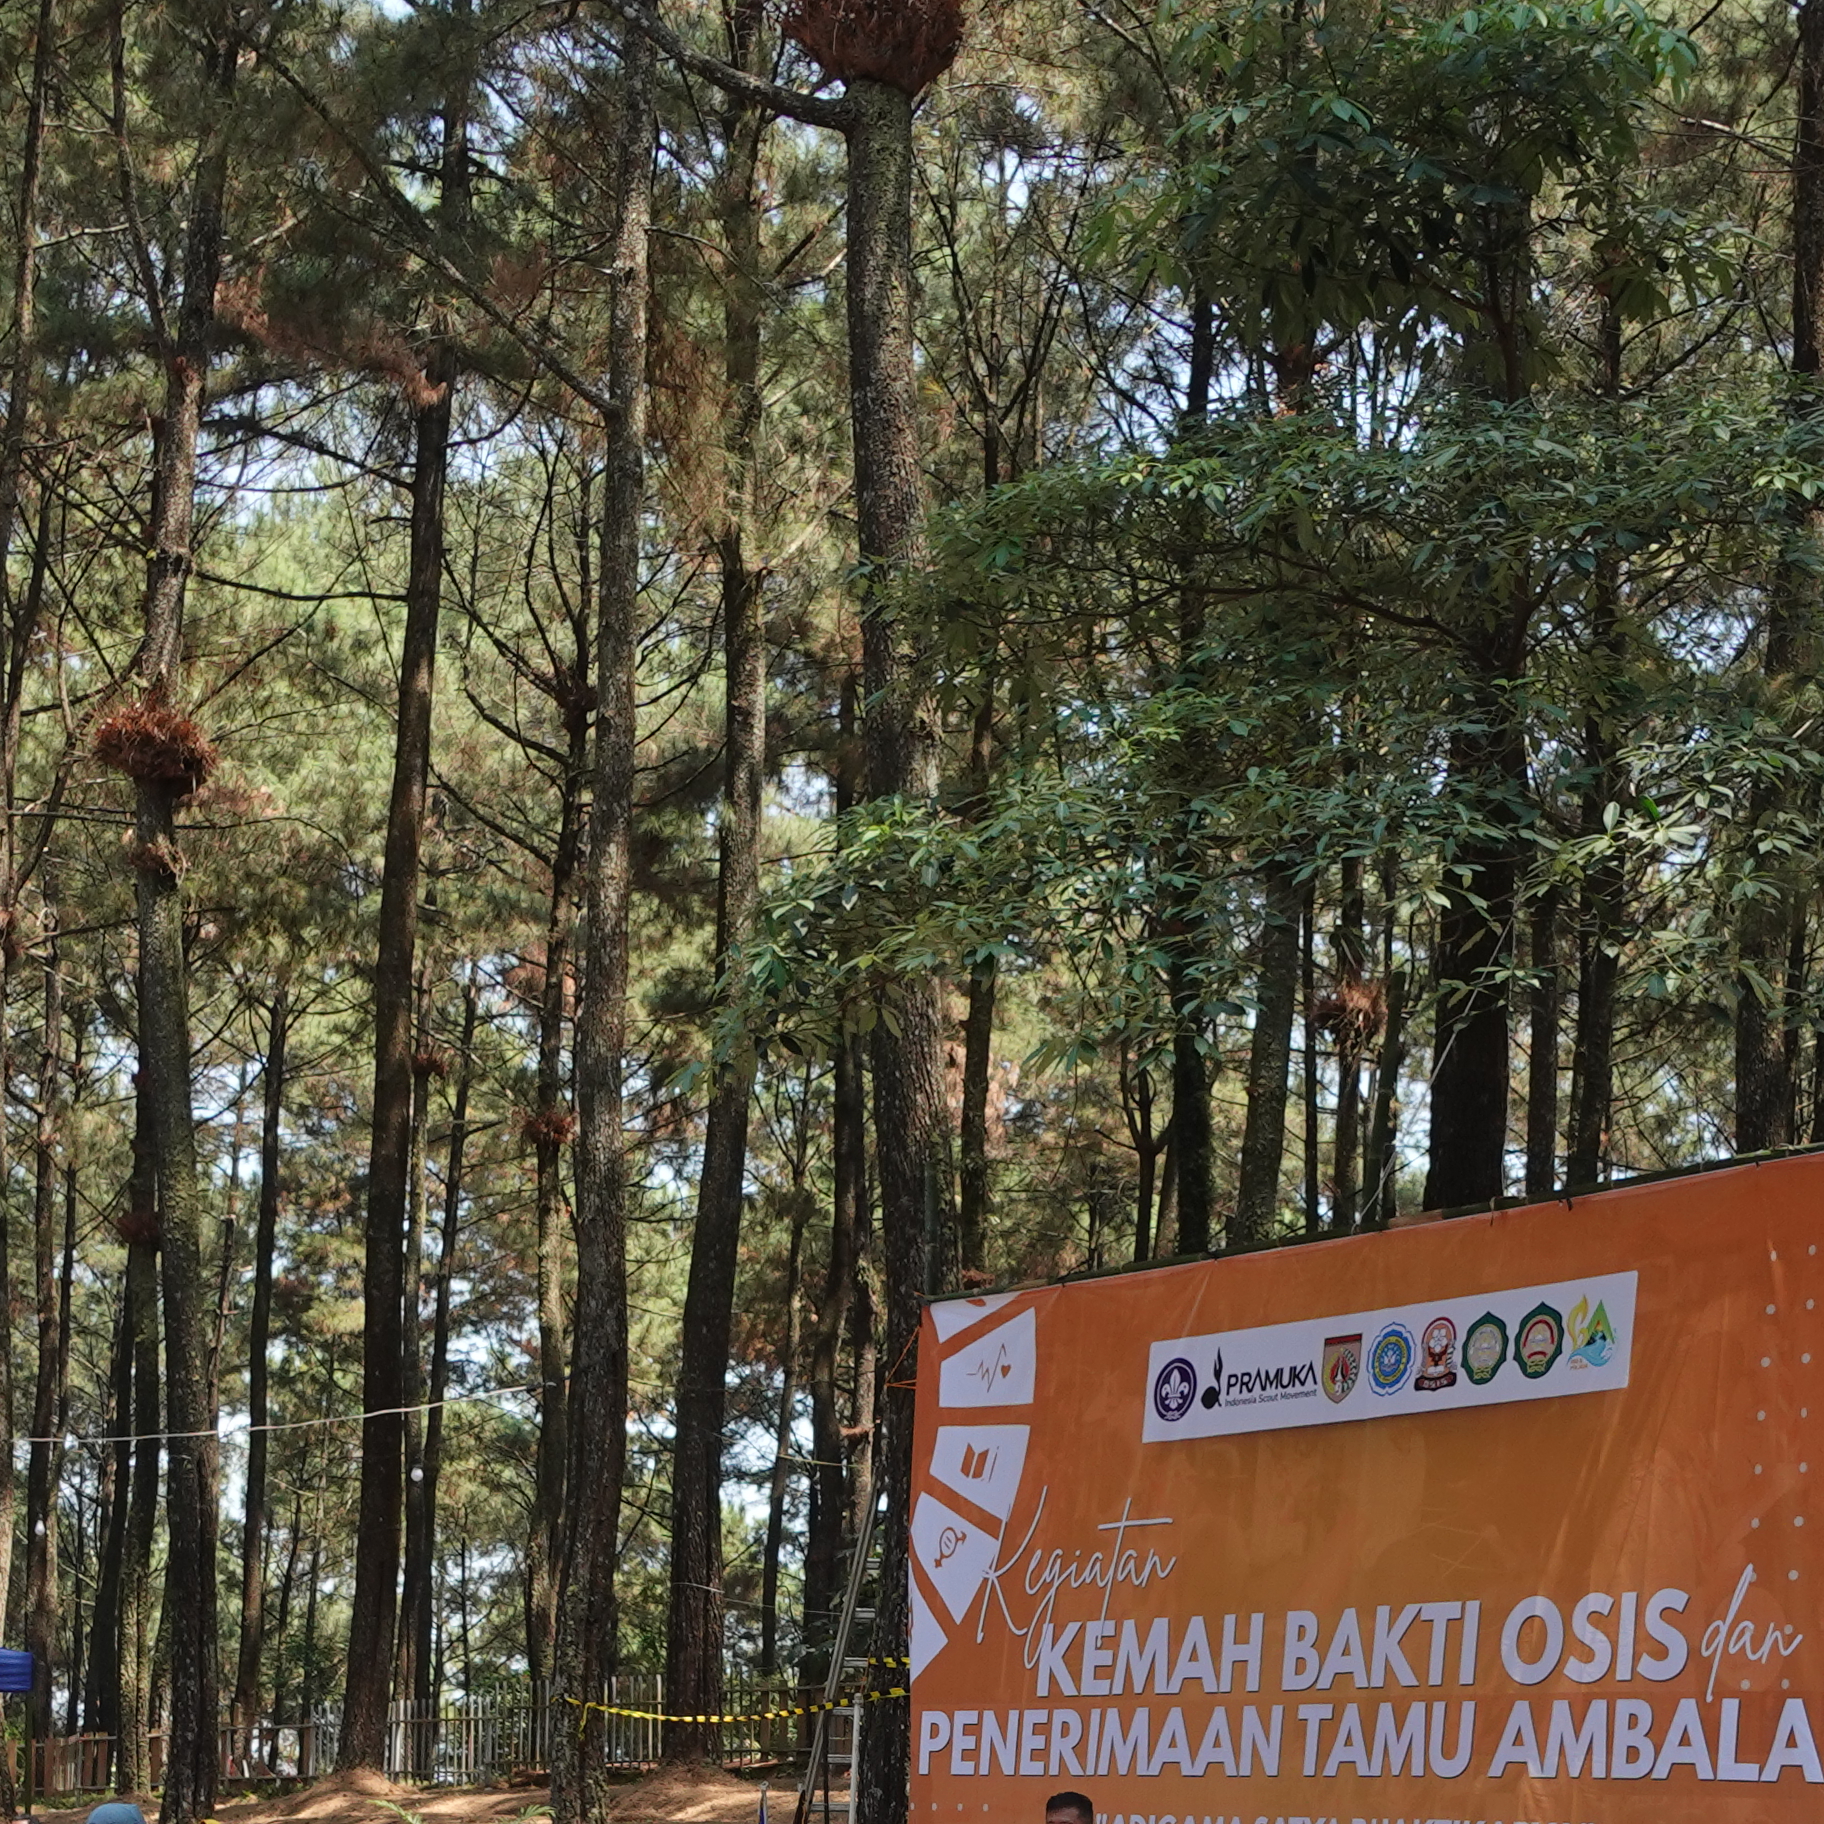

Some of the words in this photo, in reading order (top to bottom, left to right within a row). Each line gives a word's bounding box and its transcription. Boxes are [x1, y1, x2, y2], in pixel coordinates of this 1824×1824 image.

[1224, 1394, 1258, 1408] Indonesia
[1259, 1392, 1279, 1404] Scout
[1280, 1388, 1318, 1402] Movement
[1226, 1360, 1318, 1396] PRAMUKA
[977, 1485, 1176, 1669] Kegiatan
[1036, 1612, 1265, 1697] KEMAH
[1281, 1600, 1481, 1692] BAKTI
[1499, 1587, 1690, 1686] OSIS
[1700, 1563, 1803, 1703] dan
[918, 1704, 1285, 1777] PENERIMAAN
[1297, 1701, 1476, 1779] TAMU
